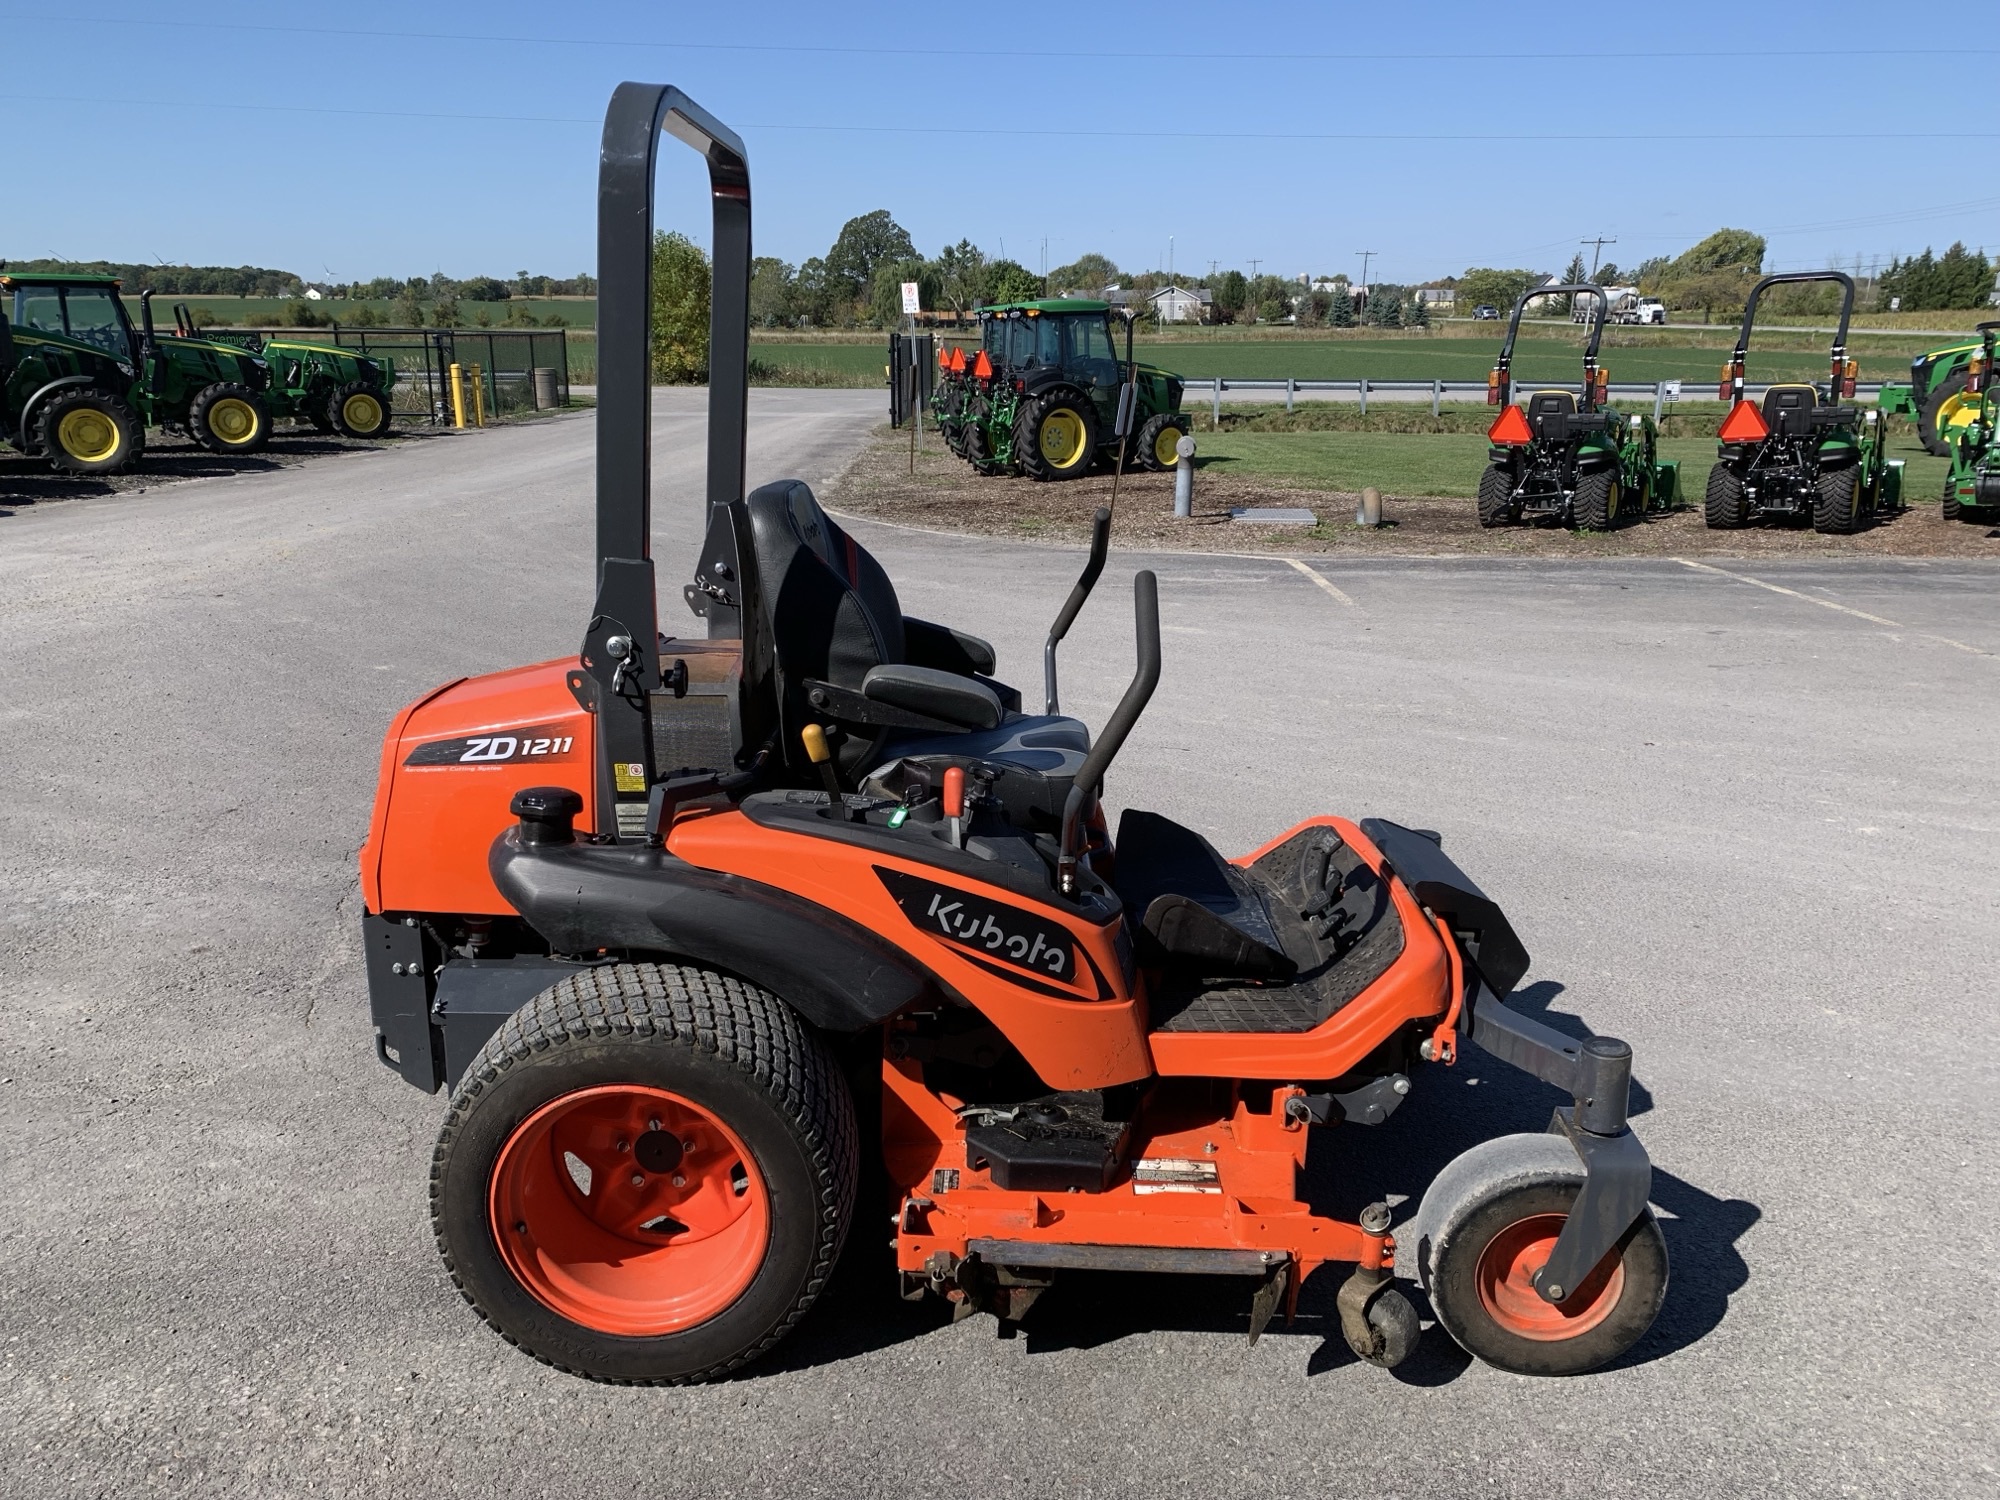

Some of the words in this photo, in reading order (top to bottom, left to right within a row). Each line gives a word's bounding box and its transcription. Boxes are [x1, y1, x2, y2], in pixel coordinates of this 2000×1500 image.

[206, 333, 252, 345] Premier
[459, 736, 518, 762] ZD
[521, 736, 574, 756] 1211
[927, 893, 1067, 974] Kubota
